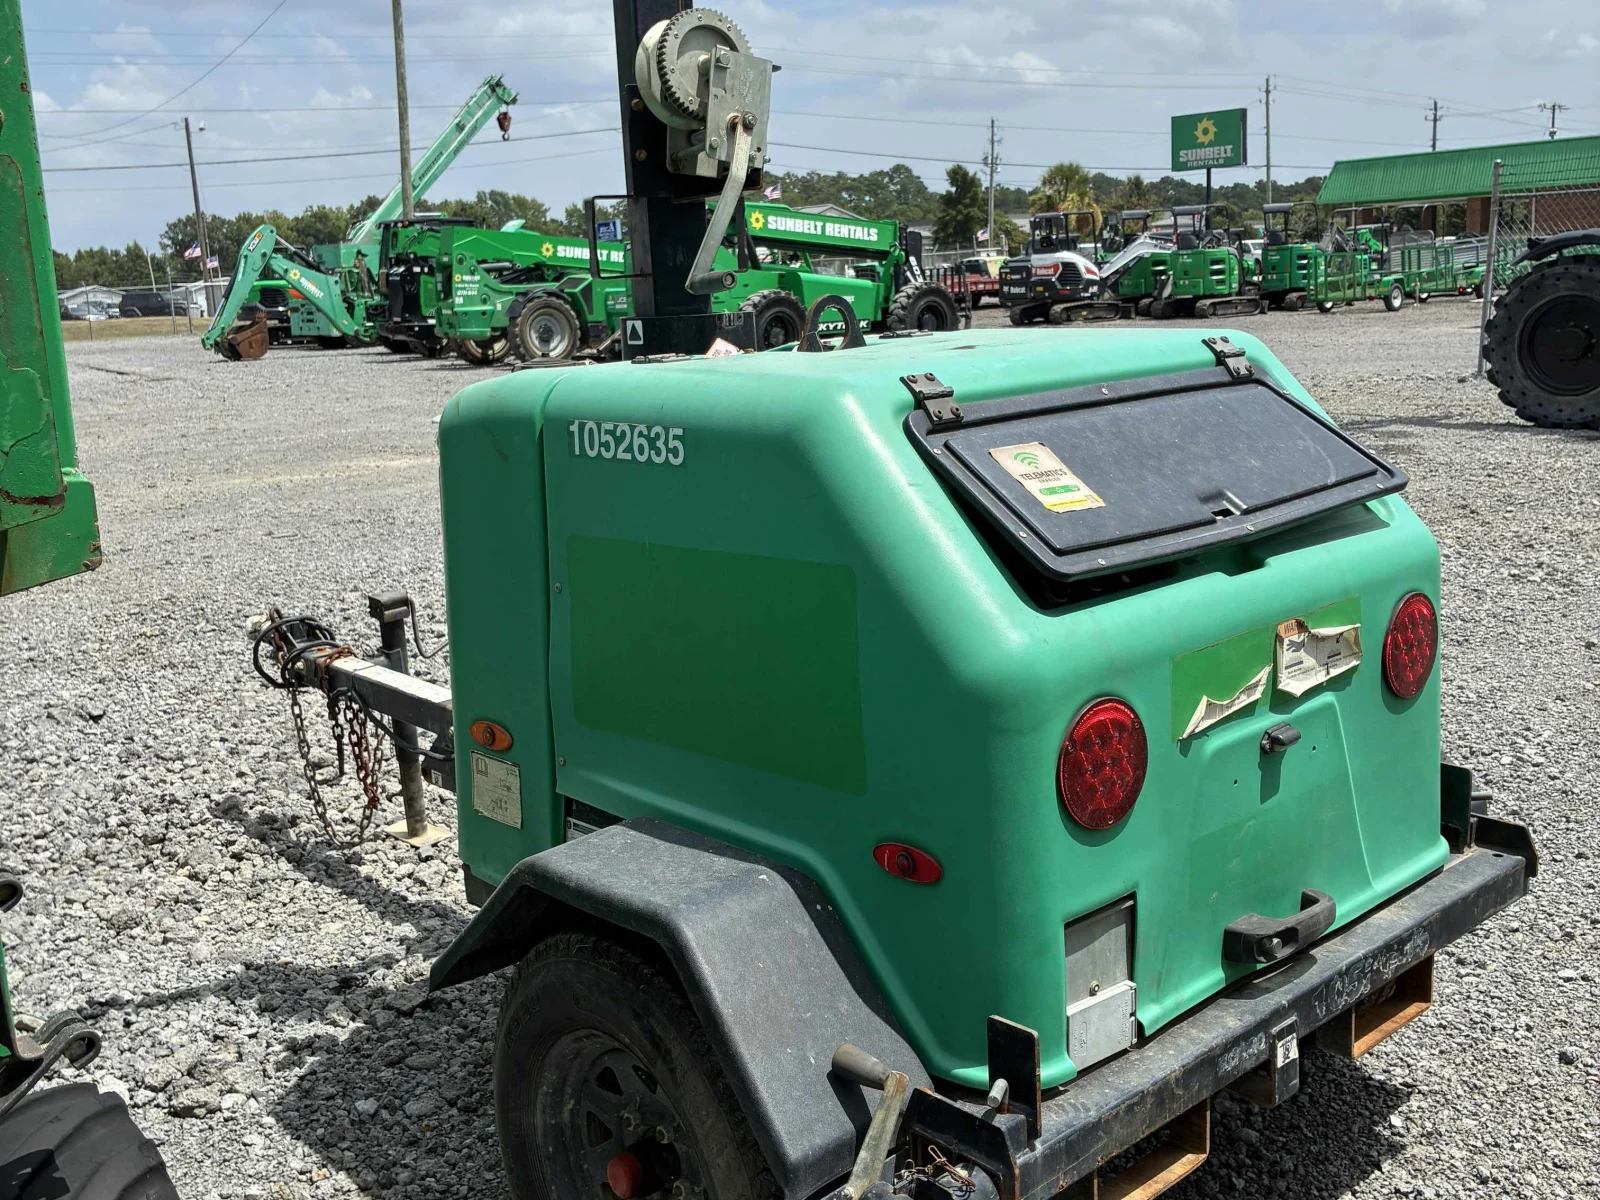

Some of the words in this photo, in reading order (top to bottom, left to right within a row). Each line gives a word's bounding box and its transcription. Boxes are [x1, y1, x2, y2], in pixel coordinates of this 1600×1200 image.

[1179, 145, 1233, 162] SUNBELT
[1187, 158, 1224, 167] RENTALS
[767, 215, 823, 235] SUNBELT
[825, 222, 878, 241] RENTALS
[556, 245, 609, 262] SUNBLT
[569, 419, 685, 466] 1052635
[1018, 468, 1067, 481] TELEMATICS
